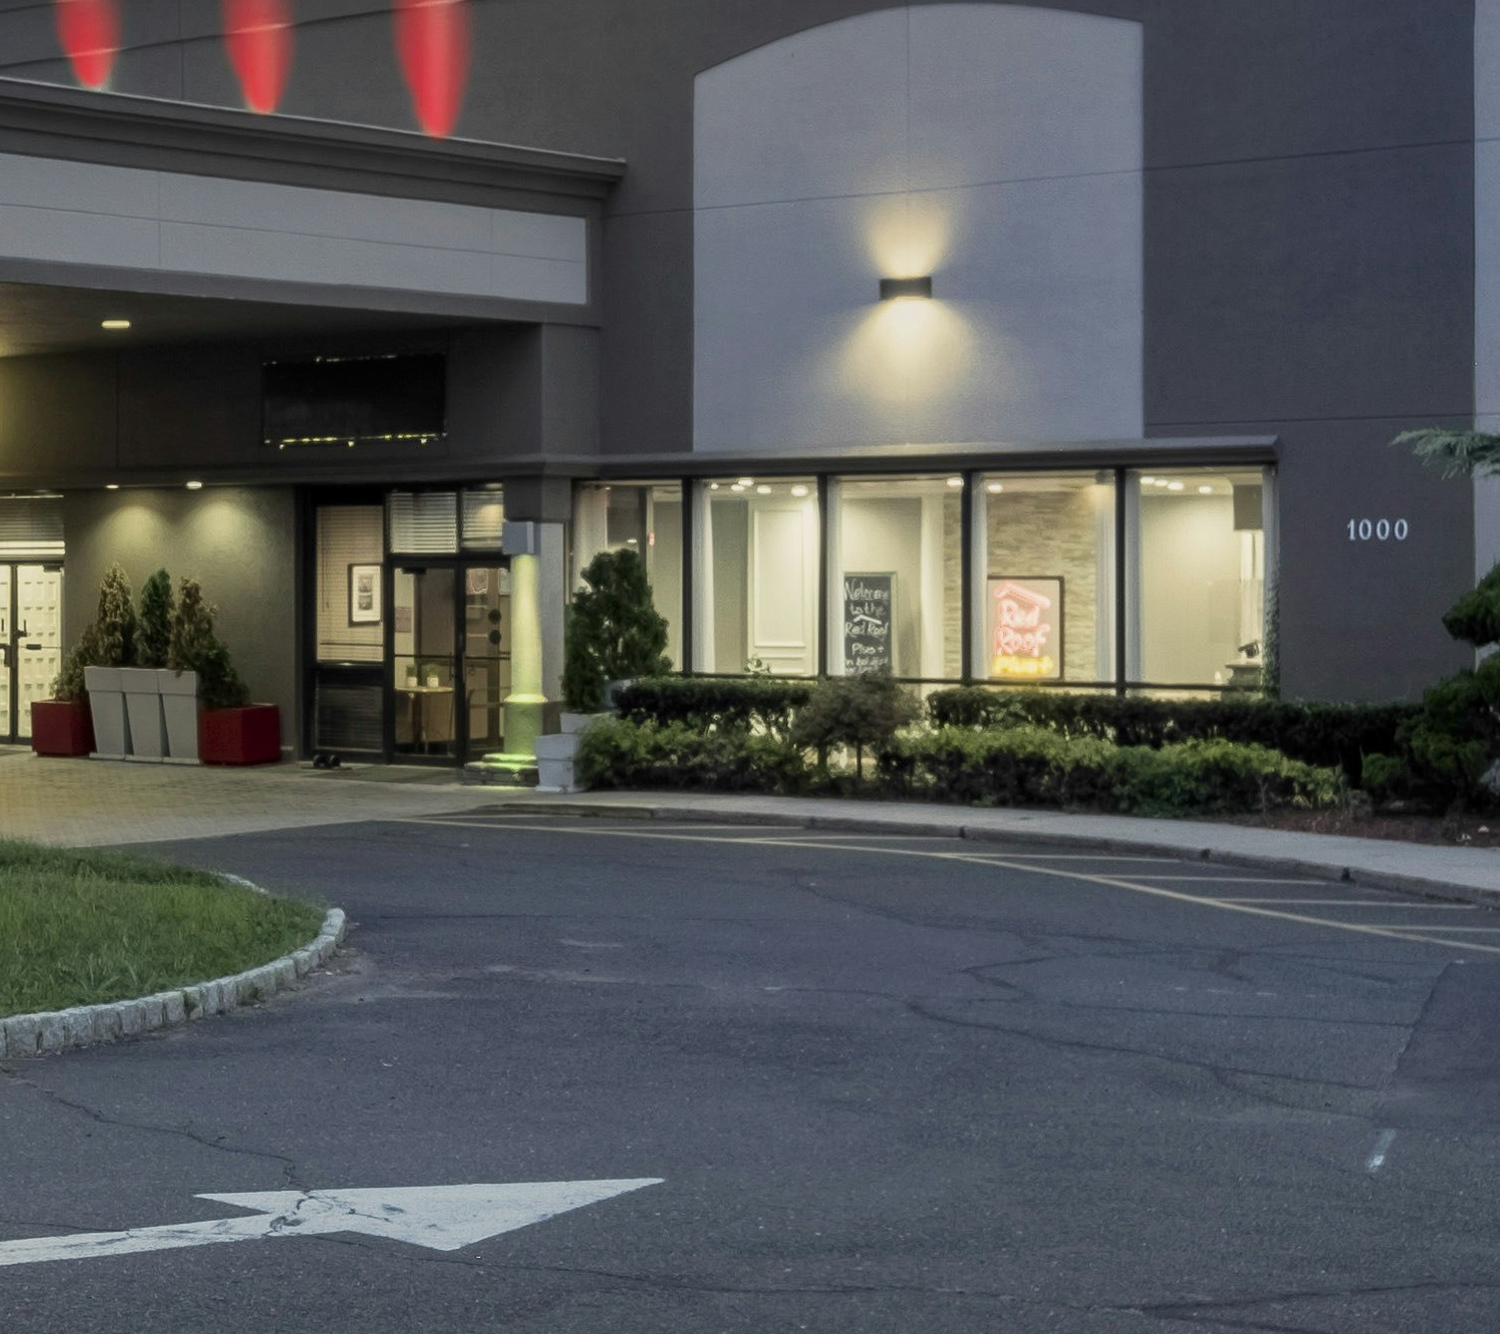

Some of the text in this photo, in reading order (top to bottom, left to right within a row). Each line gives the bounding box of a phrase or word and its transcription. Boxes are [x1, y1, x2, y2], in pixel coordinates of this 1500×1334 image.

[1347, 518, 1408, 541] 1000
[999, 599, 1040, 627] Red
[996, 623, 1051, 658] Roof
